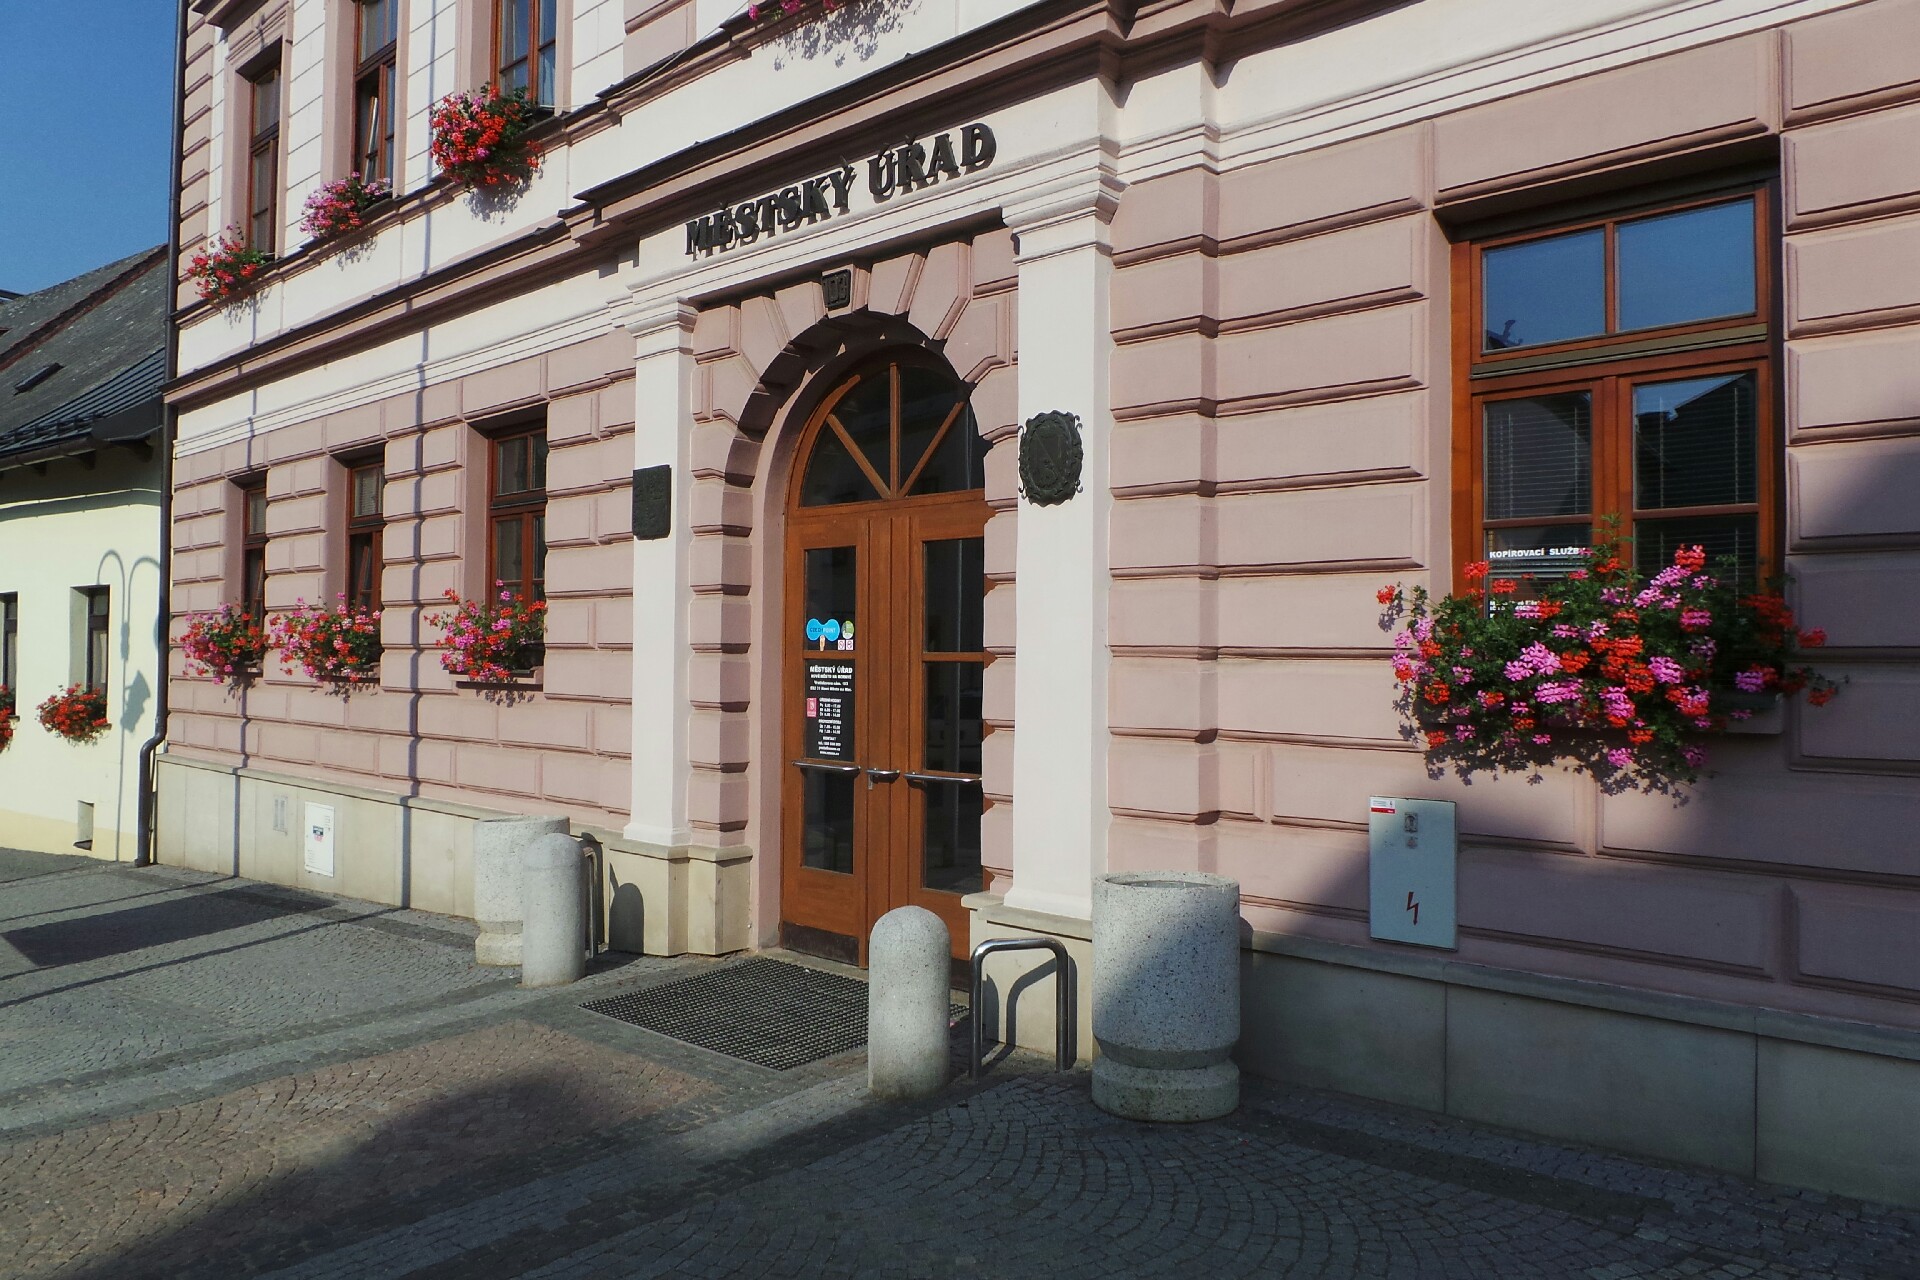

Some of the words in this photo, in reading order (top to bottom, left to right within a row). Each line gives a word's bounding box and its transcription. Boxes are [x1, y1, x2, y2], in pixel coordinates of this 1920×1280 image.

[685, 155, 857, 255] MĚSTSKÝ
[867, 123, 996, 197] ÚŘAD
[1490, 548, 1545, 558] KOPÍROVACÍ
[1549, 546, 1585, 555] SLUŽB
[810, 665, 836, 673] MĚSTSKÝ
[837, 665, 853, 674] ÚŘAD
